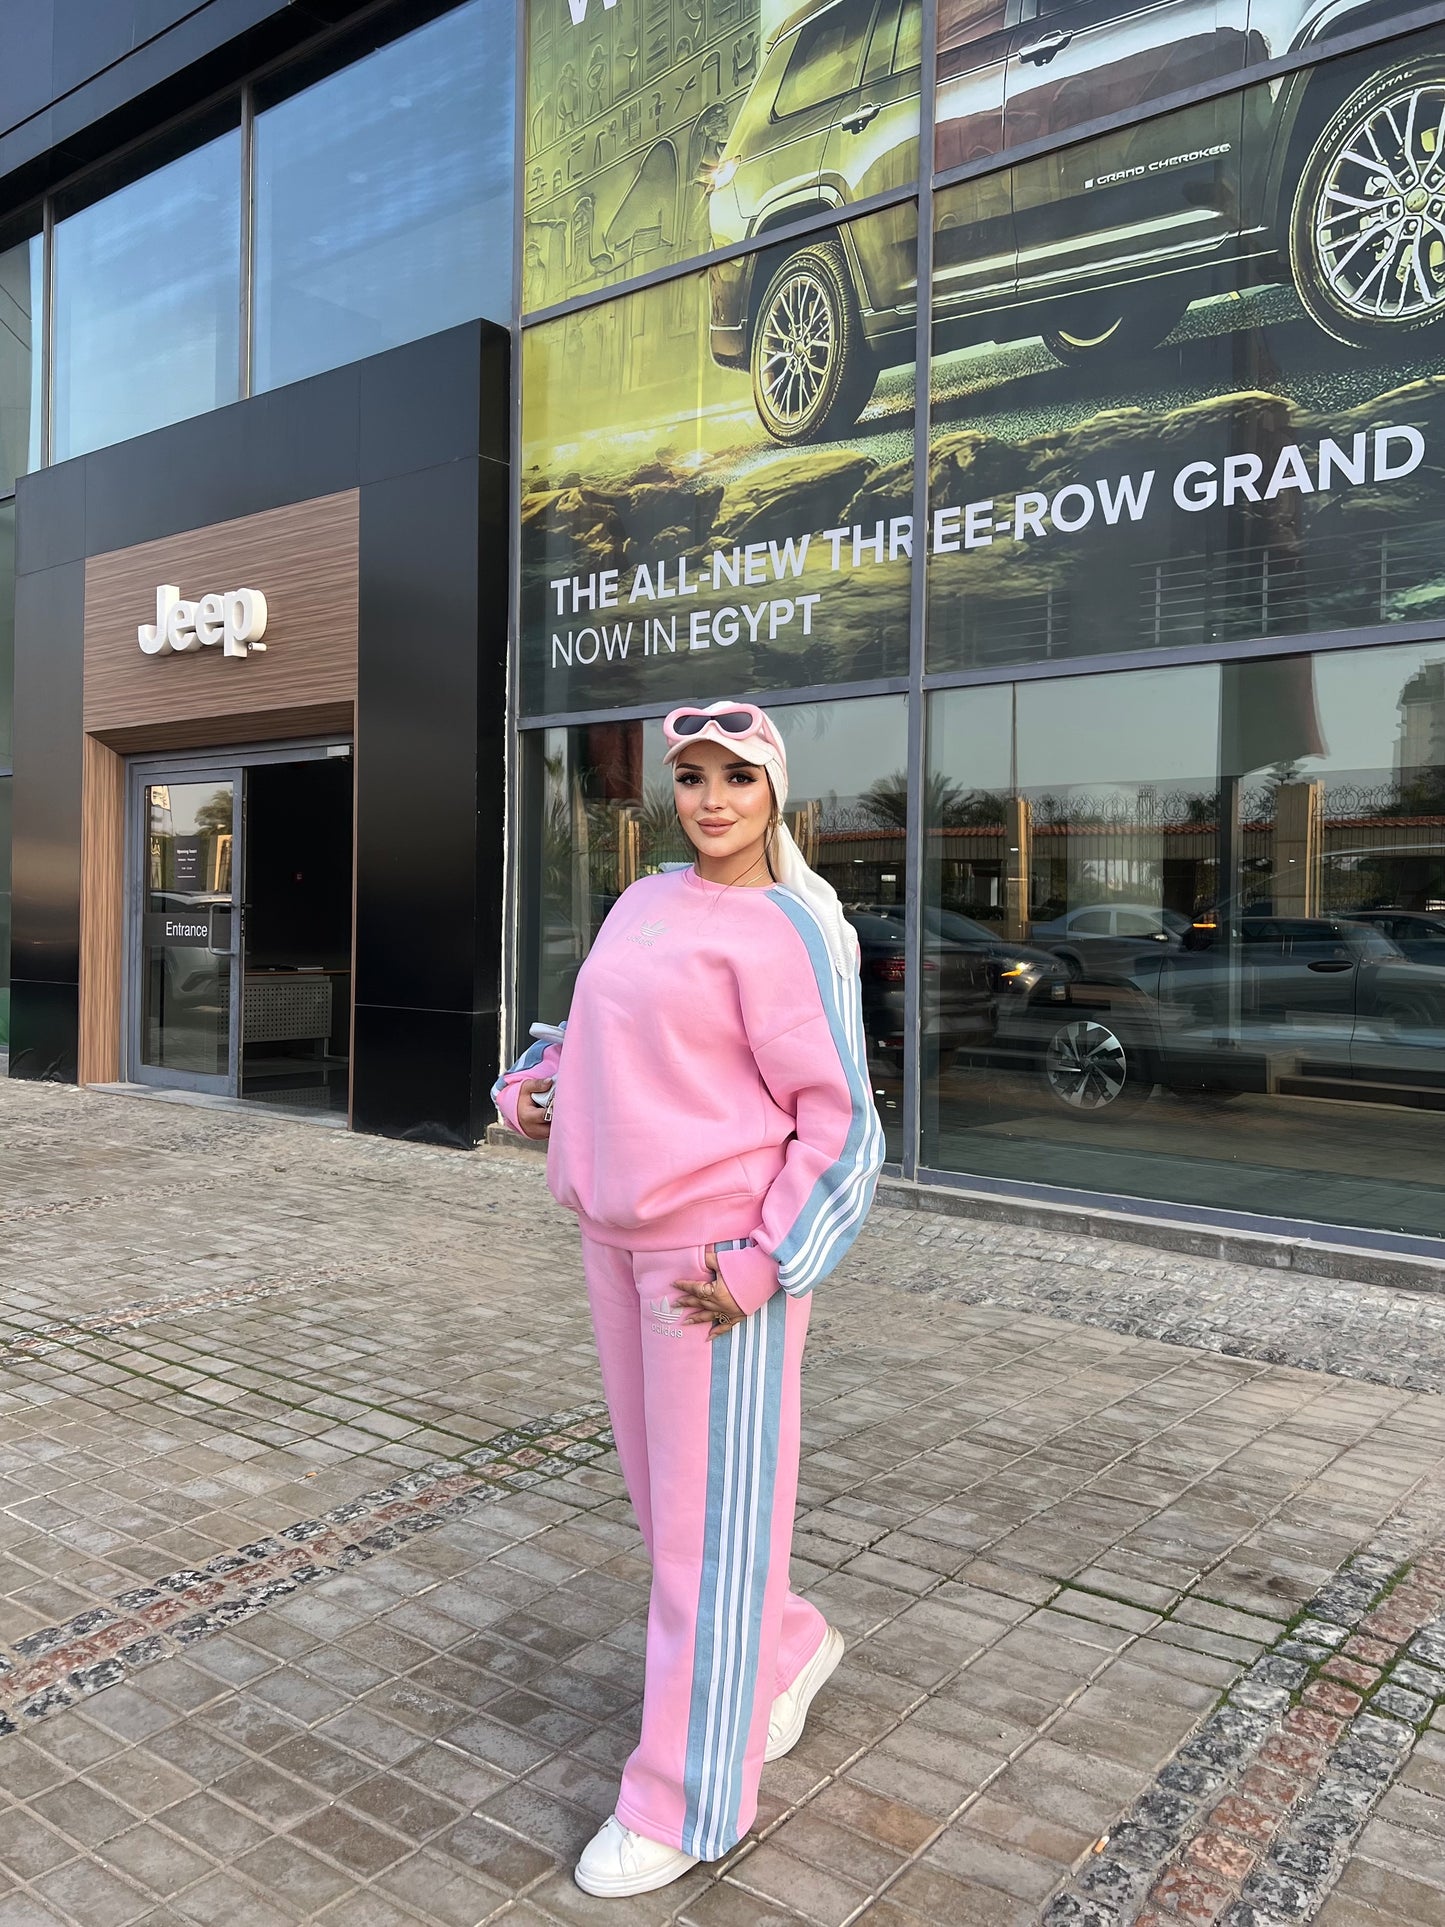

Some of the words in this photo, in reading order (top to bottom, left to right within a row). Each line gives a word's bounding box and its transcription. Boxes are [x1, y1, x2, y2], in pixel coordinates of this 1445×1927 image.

[1323, 71, 1413, 153] CONTINENTAL
[1097, 165, 1145, 185] GRAND
[1148, 143, 1232, 171] CHEROKEE
[550, 569, 619, 616] THE
[628, 533, 812, 605] ALL-NEW
[822, 469, 1157, 572] THREE-ROW
[1173, 425, 1425, 513] GRAND
[137, 584, 267, 658] Jeep
[551, 622, 633, 669] NOW
[644, 615, 677, 656] IN
[689, 593, 821, 650] EGYPT
[165, 921, 208, 937] Entrance
